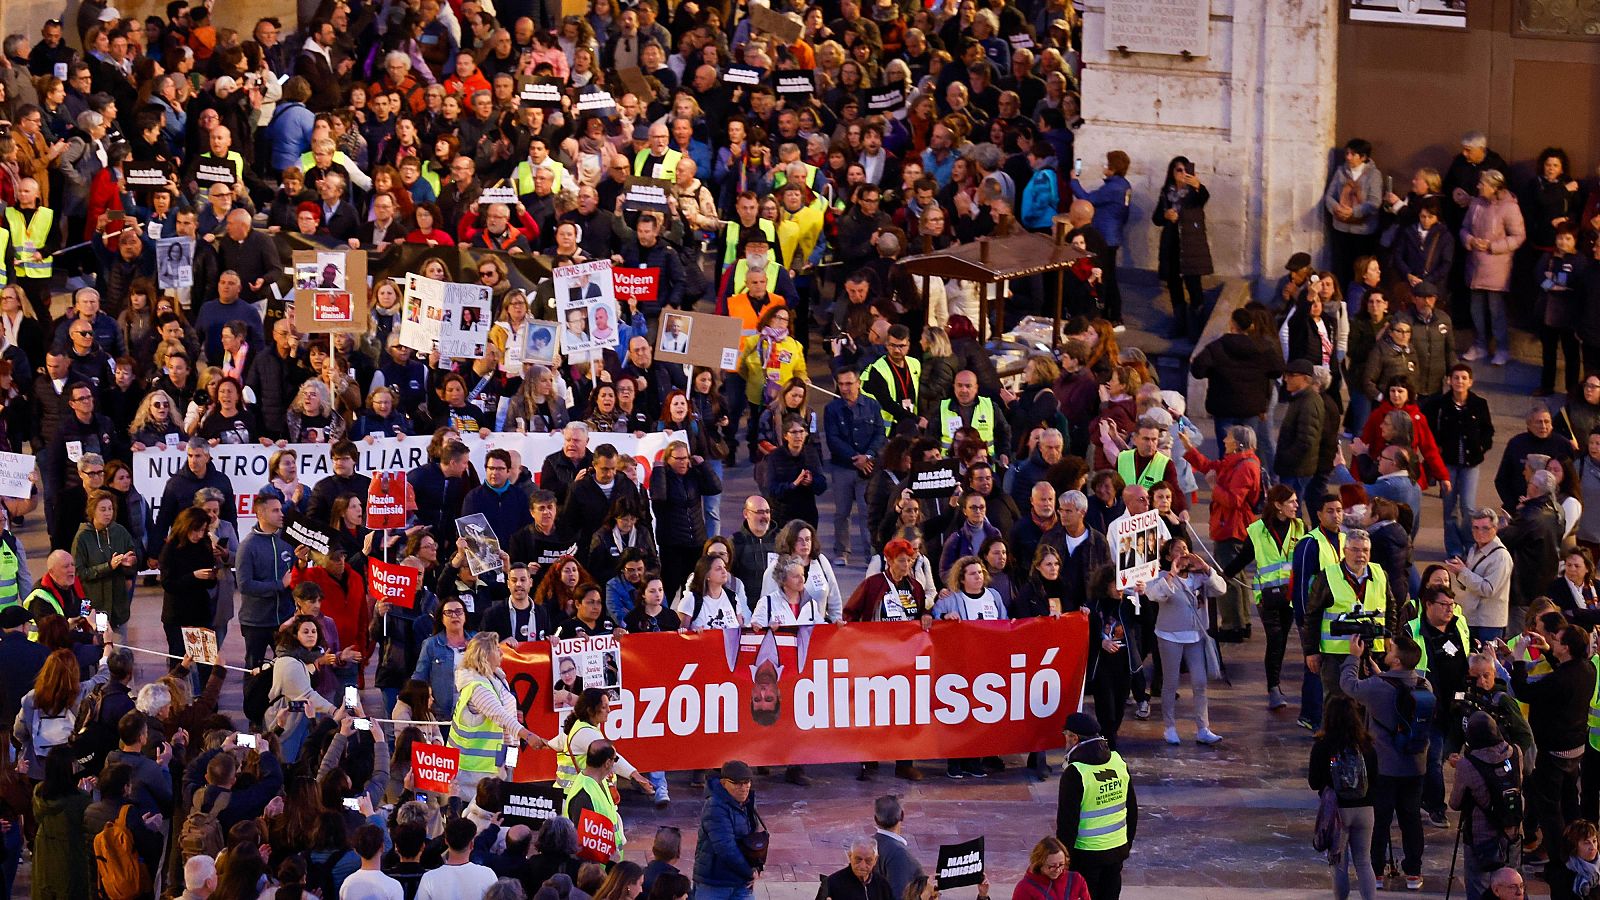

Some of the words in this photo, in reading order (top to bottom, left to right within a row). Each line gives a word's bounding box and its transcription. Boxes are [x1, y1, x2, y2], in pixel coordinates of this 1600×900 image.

[613, 272, 653, 285] Volem
[615, 284, 650, 295] votar.
[912, 476, 956, 490] DIMISSIÓ
[917, 467, 953, 481] MAZÓN
[369, 494, 395, 504] Mazón
[368, 504, 404, 515] dimissió
[292, 520, 330, 545] MAZÓN
[1119, 512, 1158, 535] JUSTICIA
[285, 526, 331, 556] DIMISSIÓ
[372, 564, 411, 587] Volem
[372, 579, 406, 598] votar.
[554, 635, 619, 656] JUSTICIA
[558, 663, 739, 740] azón
[793, 647, 1061, 731] dimissió
[415, 750, 455, 770] Volem
[418, 767, 451, 784] votar.
[1099, 779, 1122, 794] STEPV
[509, 794, 553, 809] MAZÓN
[503, 804, 557, 820] DIMISSIÓ
[582, 836, 612, 856] votar.
[946, 850, 980, 868] MAZÓN
[940, 859, 983, 879] DIMISSIÓ
